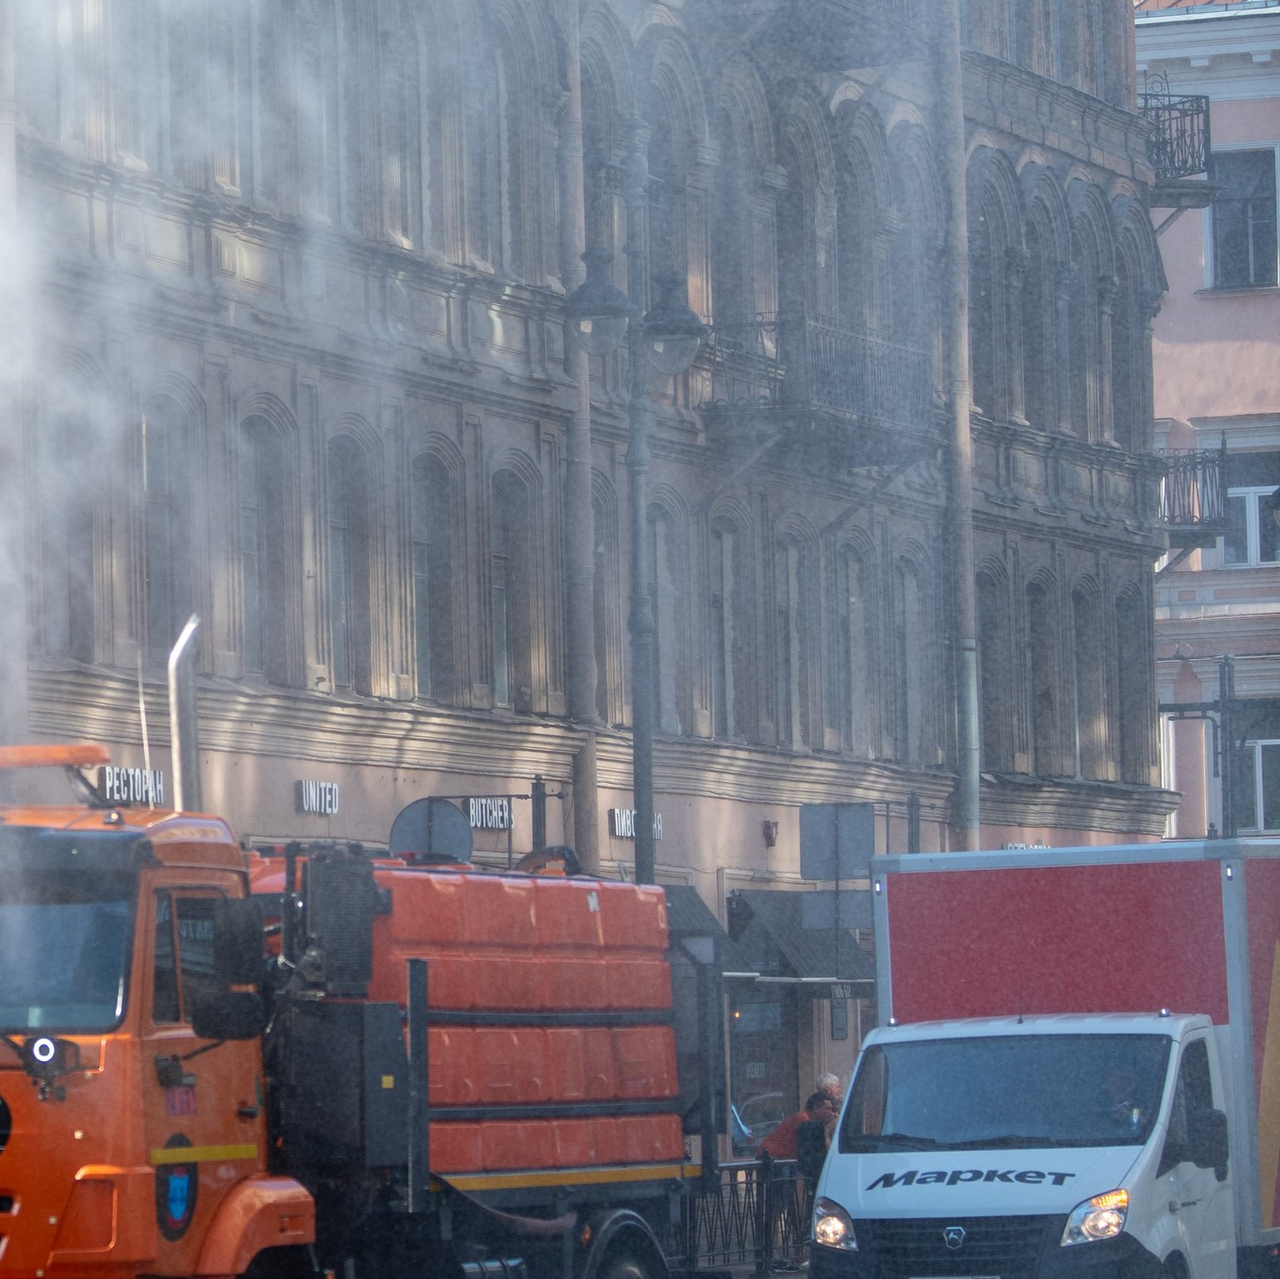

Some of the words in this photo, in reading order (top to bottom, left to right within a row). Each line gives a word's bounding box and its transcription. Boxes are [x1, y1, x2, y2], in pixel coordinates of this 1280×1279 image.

[105, 766, 164, 804] РЕСТОРАН
[302, 779, 339, 815] UNITED
[864, 1168, 1076, 1191] Маркет
